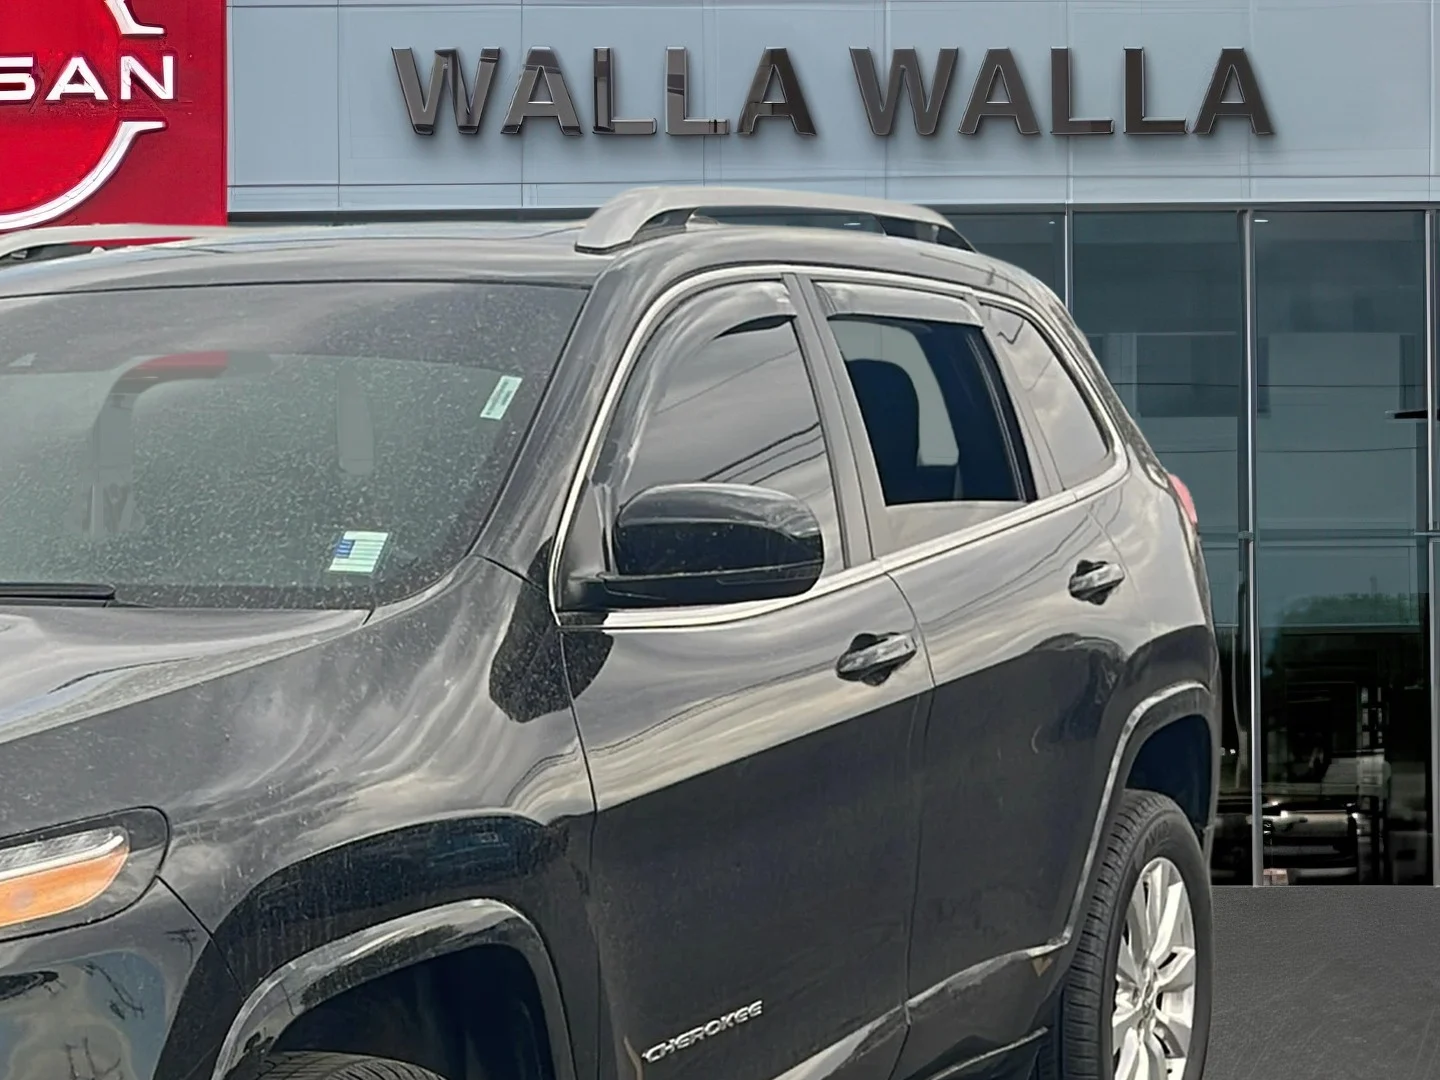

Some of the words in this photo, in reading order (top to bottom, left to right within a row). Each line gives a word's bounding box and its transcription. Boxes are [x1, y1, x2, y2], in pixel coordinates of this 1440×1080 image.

[392, 45, 817, 136] WALLA
[848, 45, 1276, 136] WALLA
[641, 1000, 763, 1063] CHEROKEE
